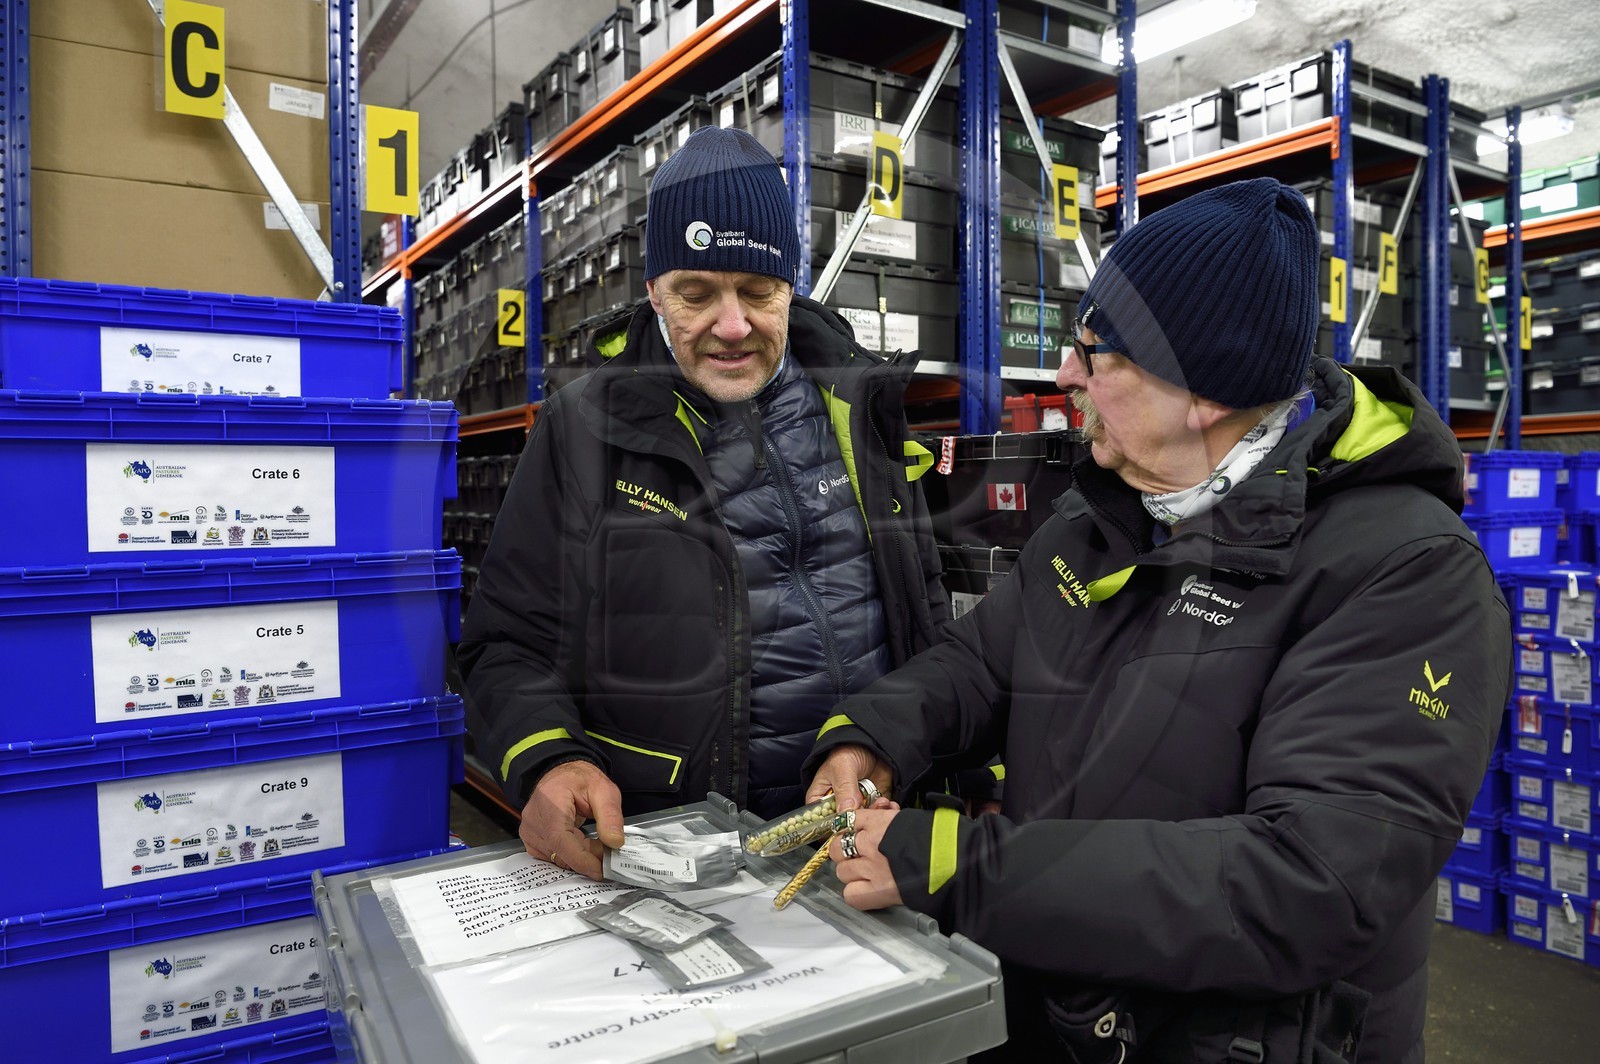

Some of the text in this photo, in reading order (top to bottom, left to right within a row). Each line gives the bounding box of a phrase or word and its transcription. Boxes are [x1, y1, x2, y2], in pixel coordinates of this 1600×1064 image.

[171, 22, 220, 98] C
[840, 114, 867, 131] IRRI
[379, 130, 407, 196] 1
[874, 146, 901, 201] D
[1058, 178, 1076, 227] E
[717, 238, 745, 247] Global
[748, 240, 767, 251] Seed
[1383, 245, 1395, 282] F
[1478, 260, 1489, 293] G
[1334, 272, 1343, 310] 1
[503, 300, 521, 337] 2
[1522, 308, 1529, 340] 1
[233, 354, 272, 364] Crate 7
[252, 468, 300, 480] Crate 6
[616, 480, 688, 521] ELLY HANSEN
[1051, 555, 1076, 583] HELLY
[1190, 587, 1211, 598] Global
[1211, 593, 1231, 606] Seed
[256, 625, 304, 638] Crate 5
[261, 778, 308, 794] Crate 9
[182, 838, 201, 846] mla
[483, 867, 528, 881] Nansens
[442, 879, 513, 896] Gardermoen
[446, 870, 559, 903] N-2061 Gardermoen
[448, 891, 510, 909] Telephone
[513, 885, 532, 893] +47
[458, 904, 510, 925] Svalbard
[554, 887, 581, 896] Seed
[500, 900, 553, 919] NordGen
[466, 923, 505, 938] Phone
[508, 913, 529, 924] +47
[176, 956, 206, 964] AUSTRALIAN
[270, 942, 305, 955] Crate
[176, 964, 203, 972] GENEBANK
[764, 966, 824, 988] World
[191, 1002, 210, 1010] mla
[548, 1023, 624, 1050] Centre
